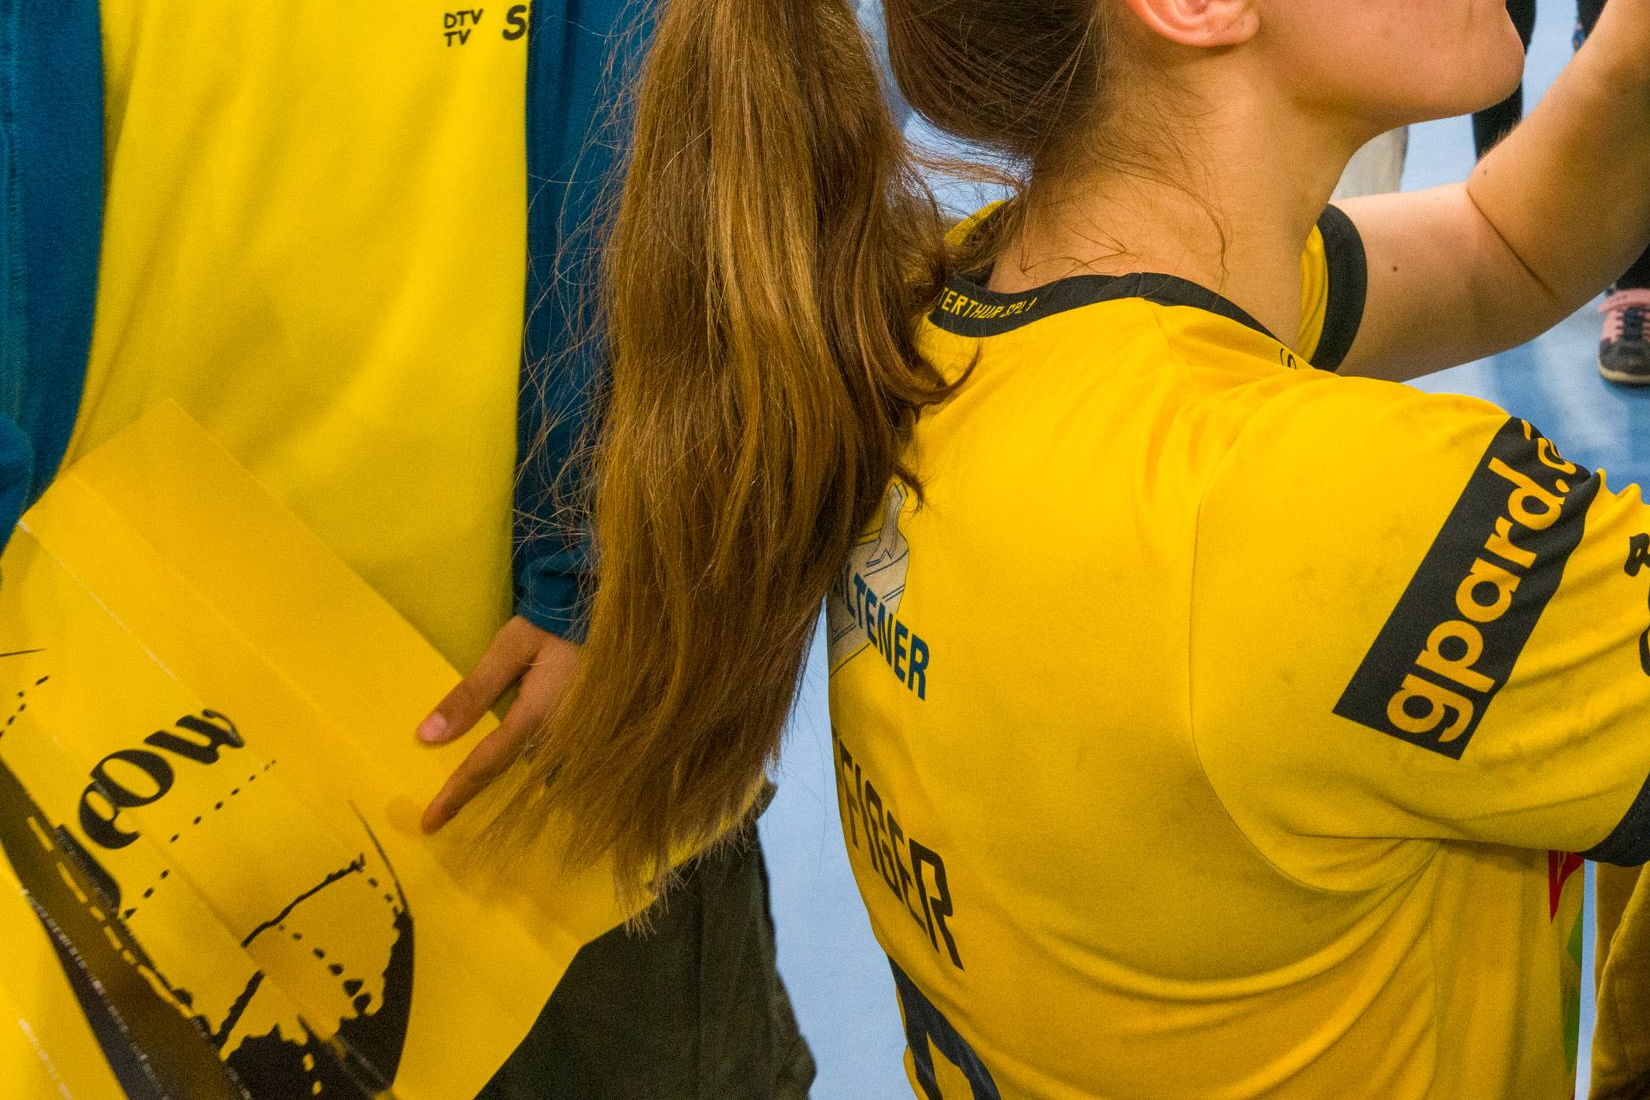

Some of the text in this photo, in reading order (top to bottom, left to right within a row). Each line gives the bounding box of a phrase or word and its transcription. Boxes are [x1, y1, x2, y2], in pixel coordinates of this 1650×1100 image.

[444, 8, 484, 29] DTV
[443, 28, 472, 48] TV
[838, 563, 931, 701] LTENER
